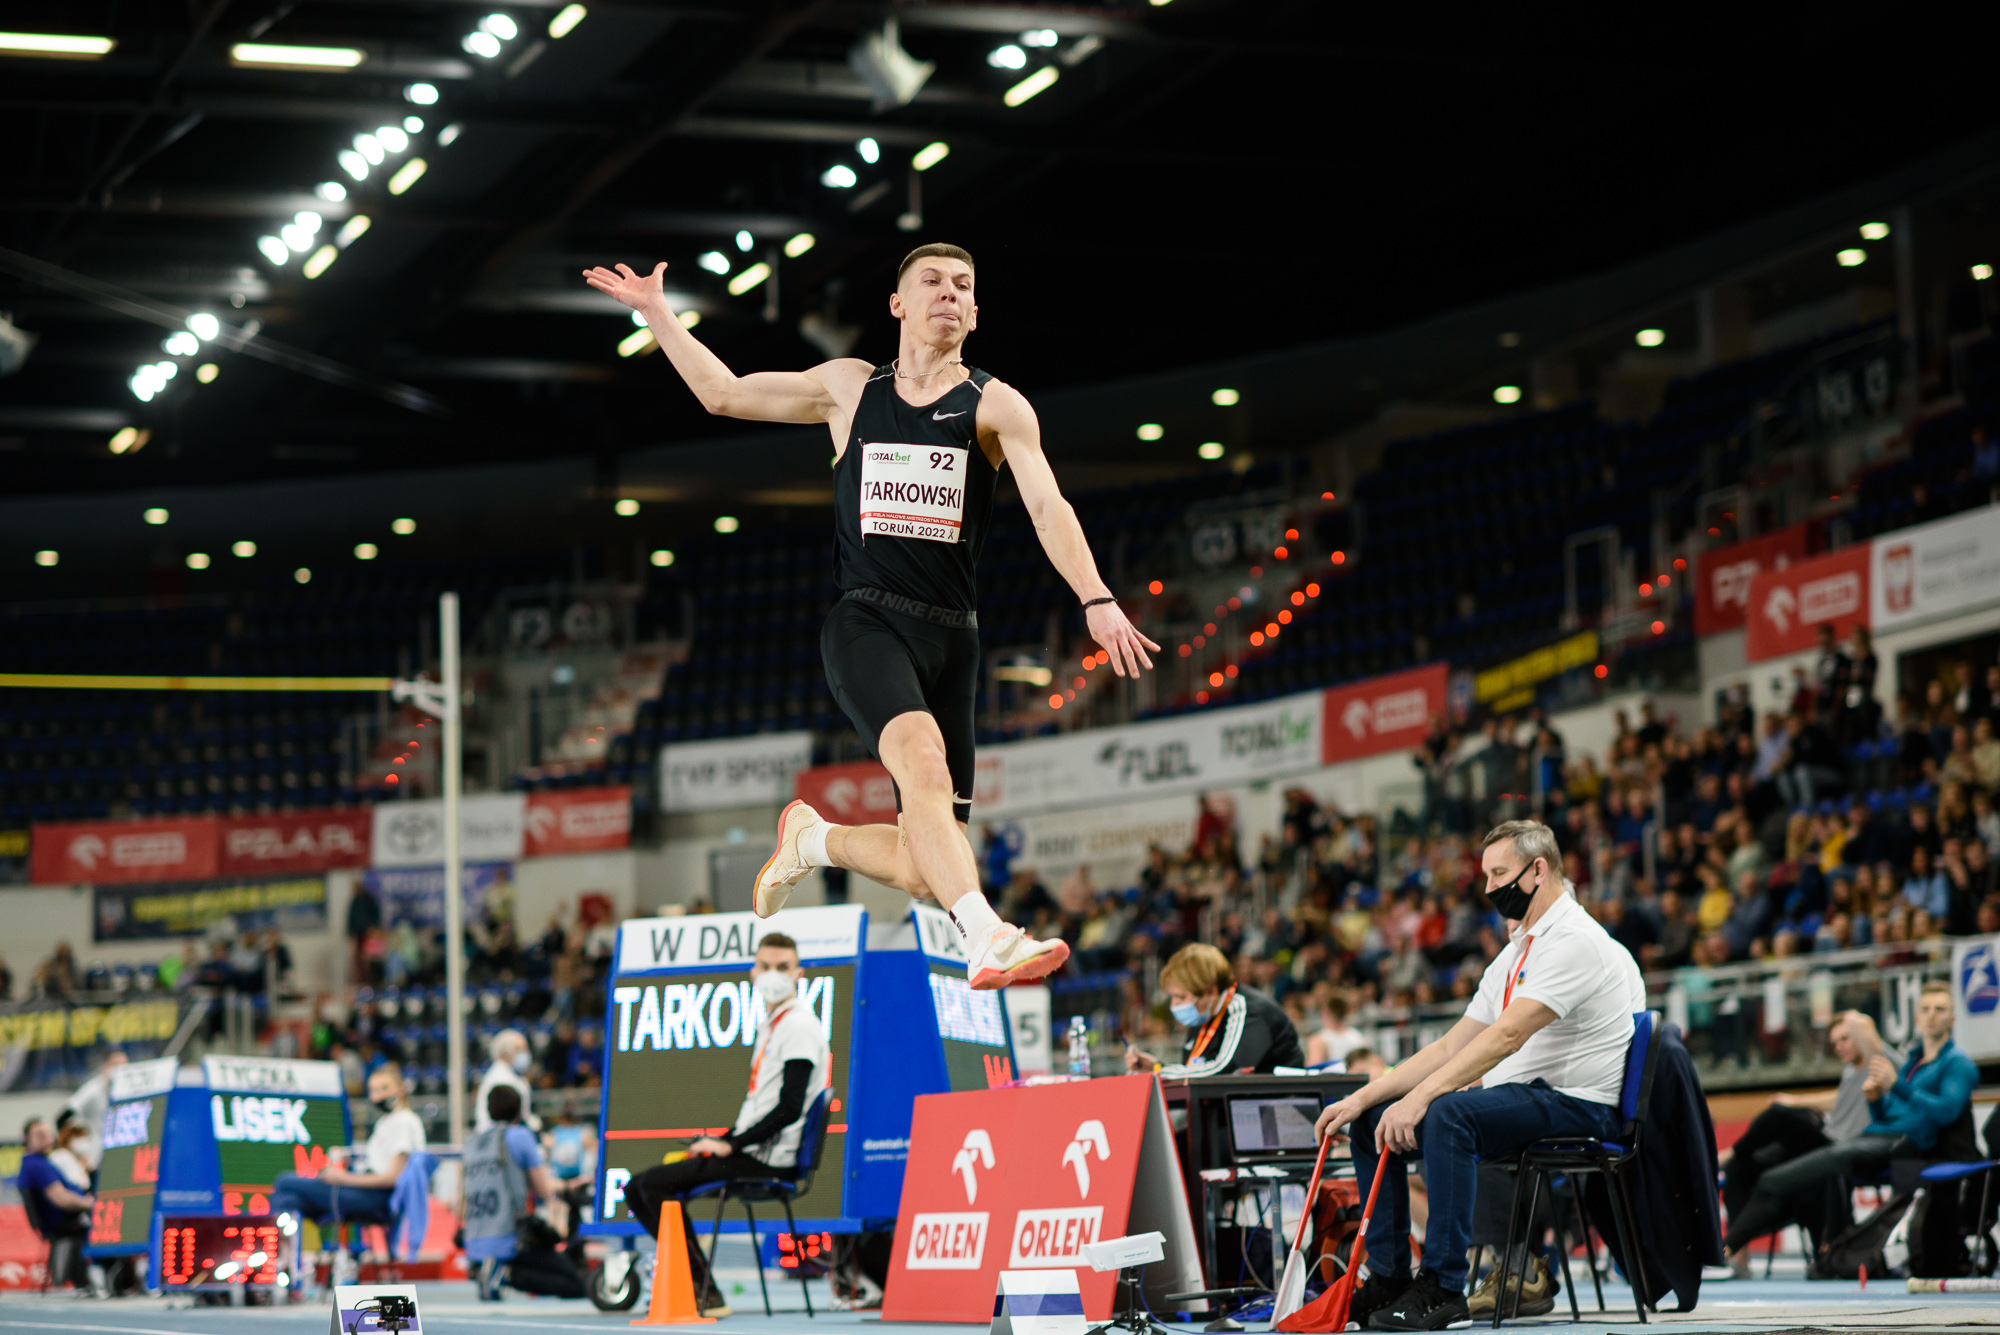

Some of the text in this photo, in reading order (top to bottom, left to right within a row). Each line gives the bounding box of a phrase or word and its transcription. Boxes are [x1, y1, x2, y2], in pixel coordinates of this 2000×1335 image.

[930, 452, 954, 471] 92
[865, 481, 961, 509] TARKOWSKI
[873, 521, 946, 539] TORUŃ 2022
[881, 591, 929, 617] NIKE
[927, 605, 964, 626] PRO
[651, 922, 758, 962] W DAL
[613, 976, 835, 1052] TARKOWKI
[1018, 1012, 1041, 1048] 5
[211, 1095, 311, 1145] LISEK
[915, 1222, 981, 1260] ORLEN
[1018, 1217, 1095, 1259] ORLEN
